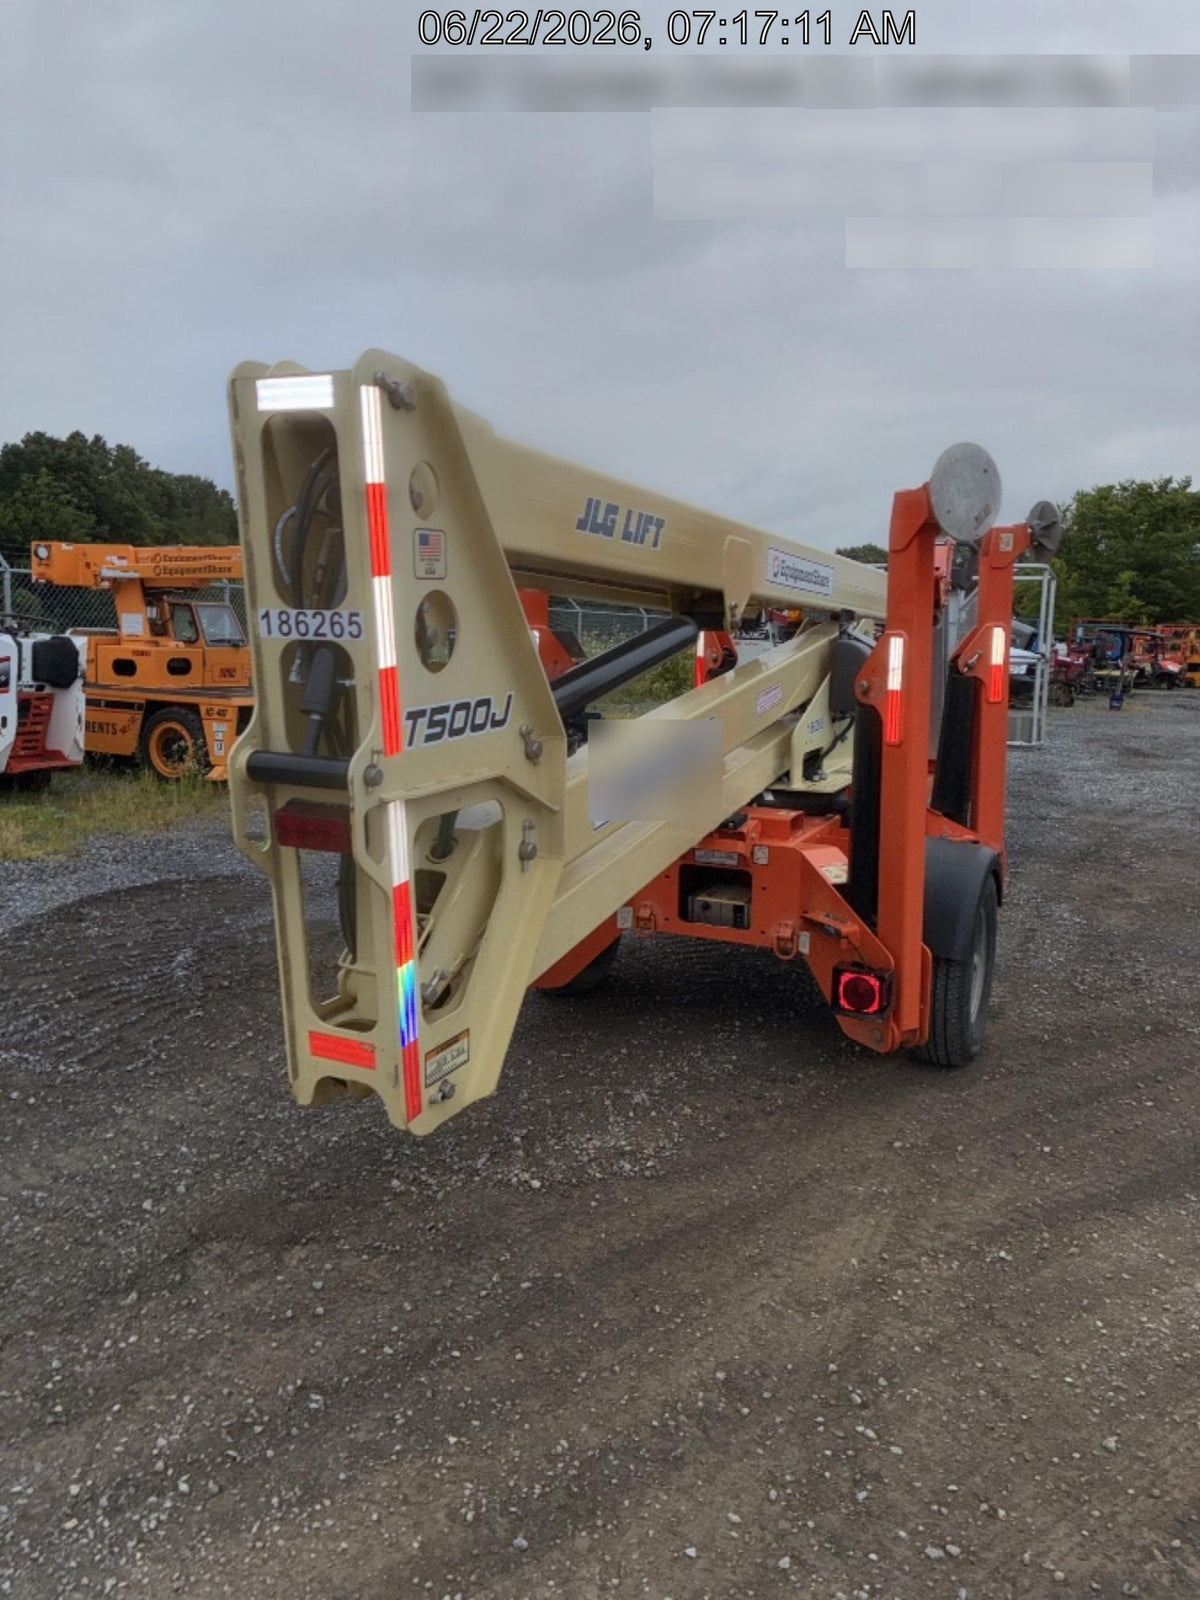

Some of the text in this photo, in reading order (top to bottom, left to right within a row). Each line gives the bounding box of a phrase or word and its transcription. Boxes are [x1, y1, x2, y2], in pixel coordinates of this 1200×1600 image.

[576, 497, 666, 549] JLG LIFT
[260, 609, 363, 639] 186265
[405, 694, 513, 748] T500J
